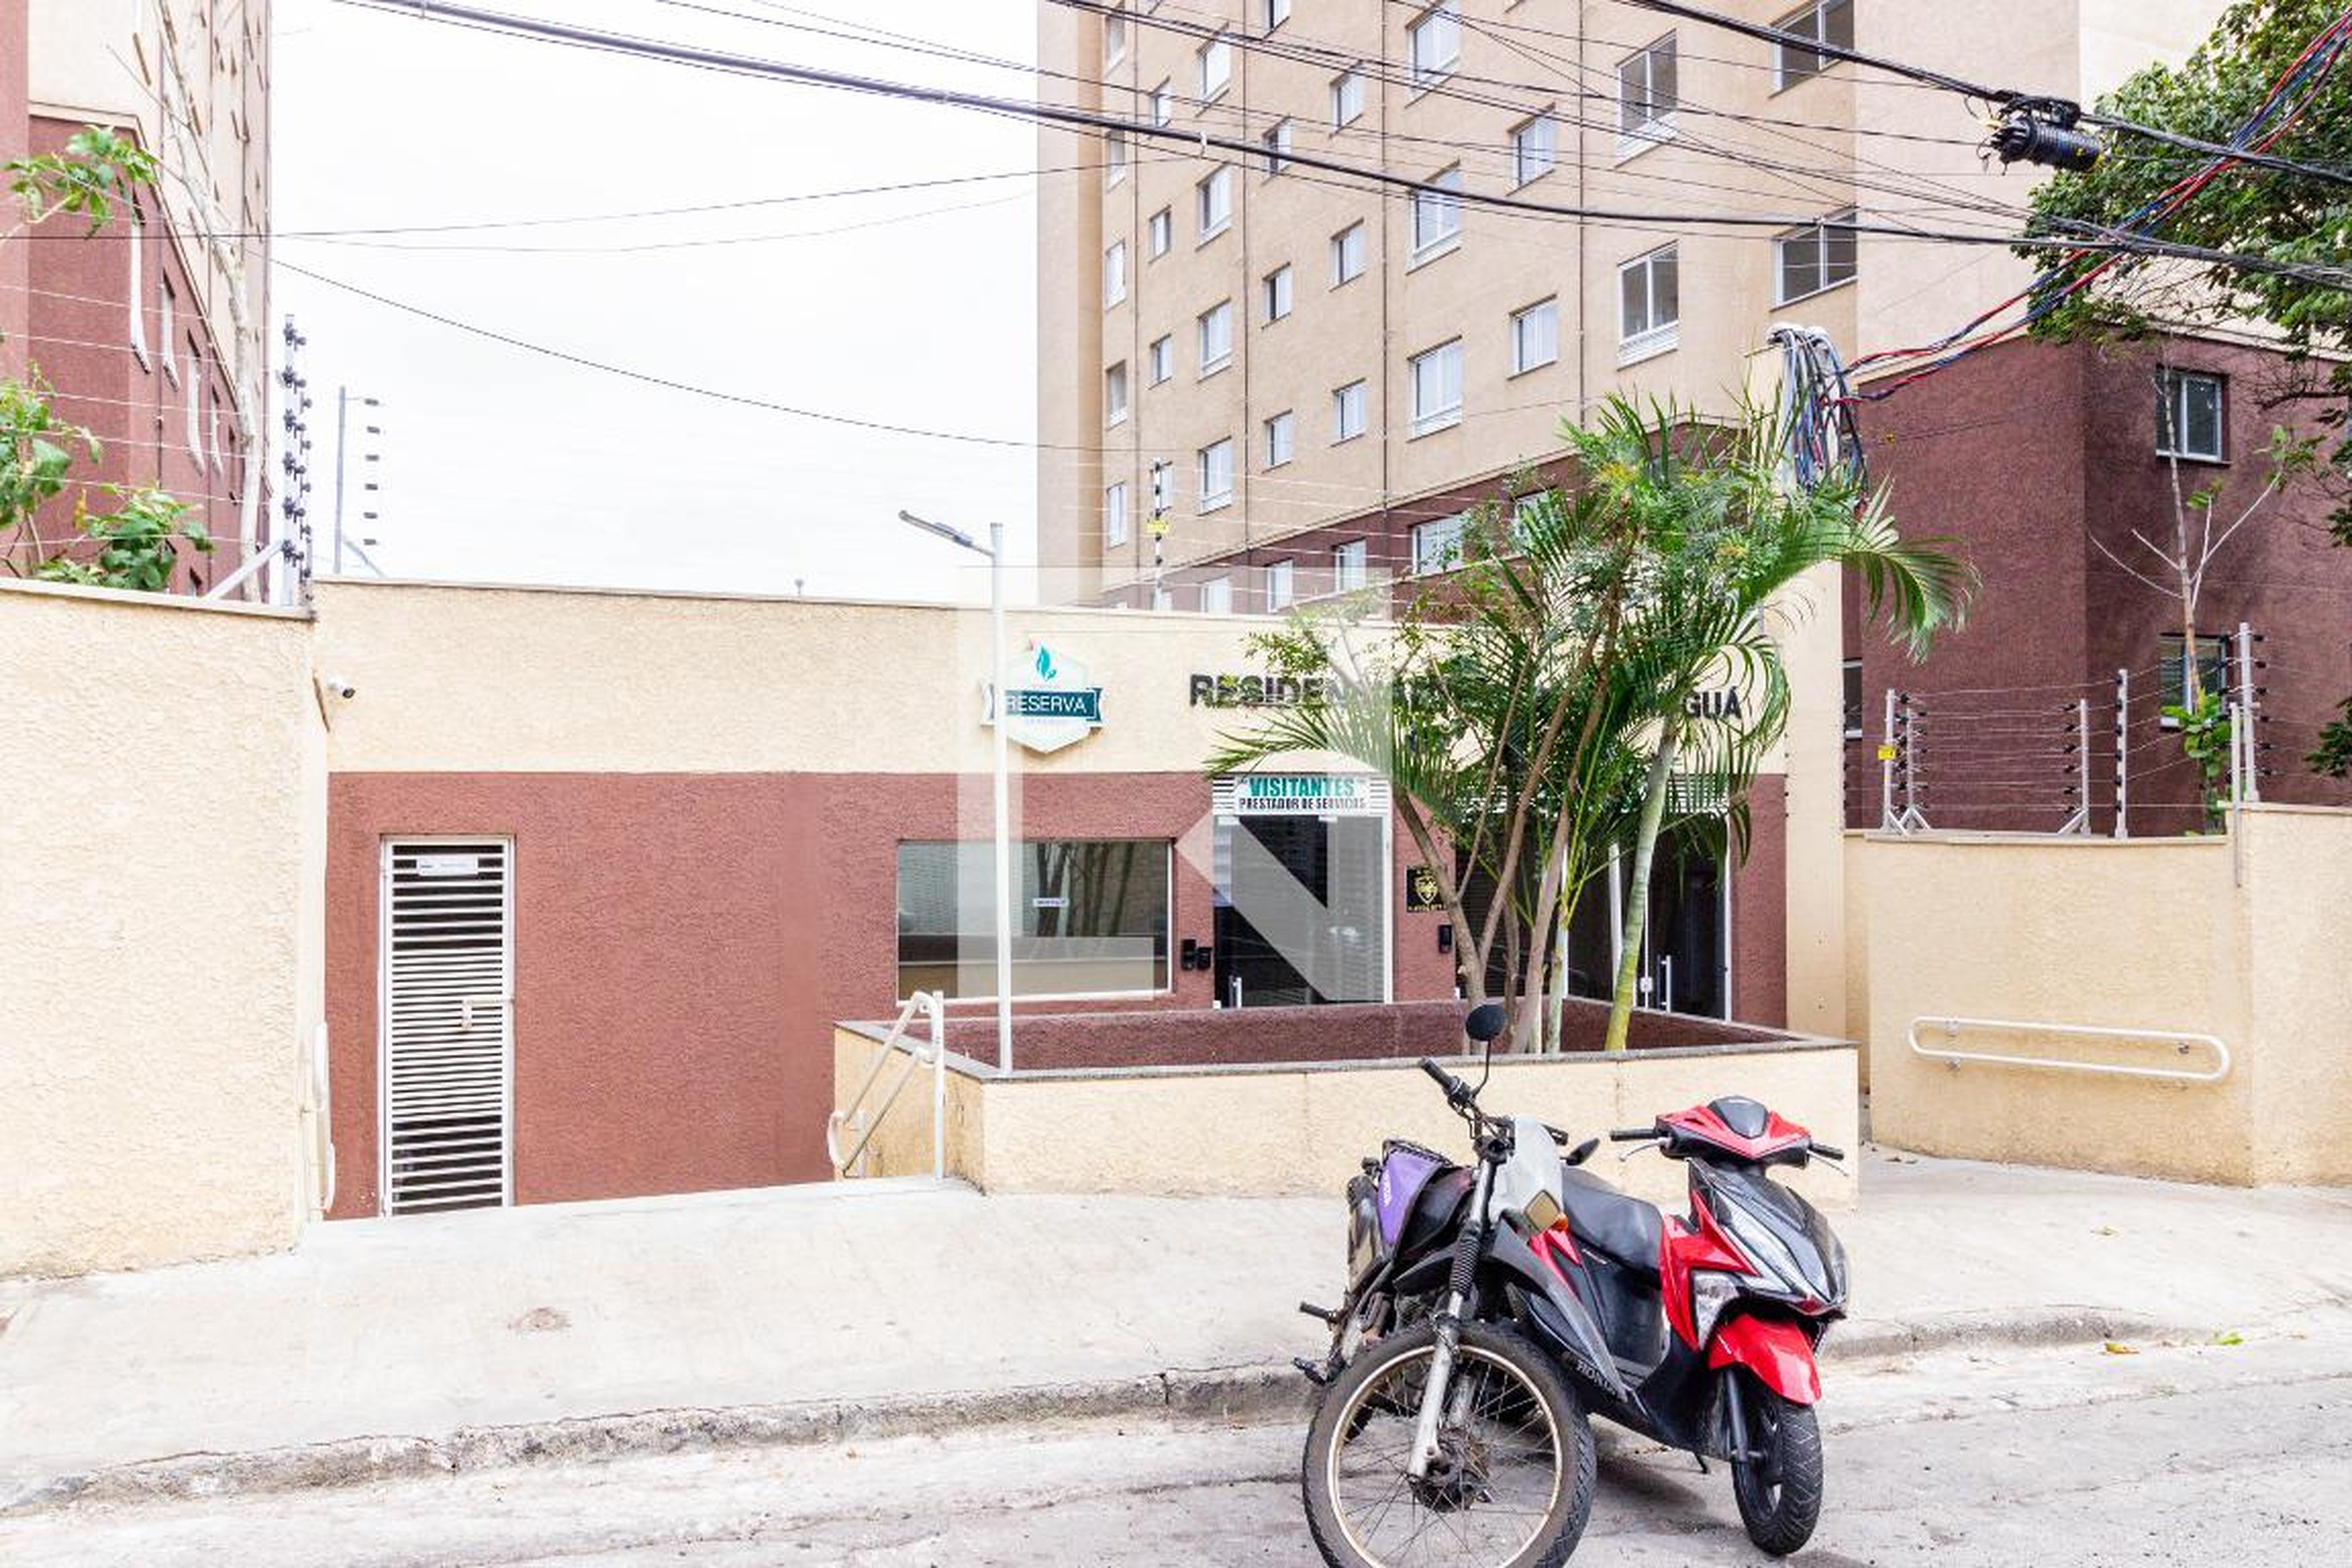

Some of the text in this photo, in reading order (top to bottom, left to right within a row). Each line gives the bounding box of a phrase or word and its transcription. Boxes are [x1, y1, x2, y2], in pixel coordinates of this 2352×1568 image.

[1007, 696, 1087, 713] RESERVA
[1240, 797, 1299, 810] PRESTADOR
[1302, 797, 1313, 810] DE
